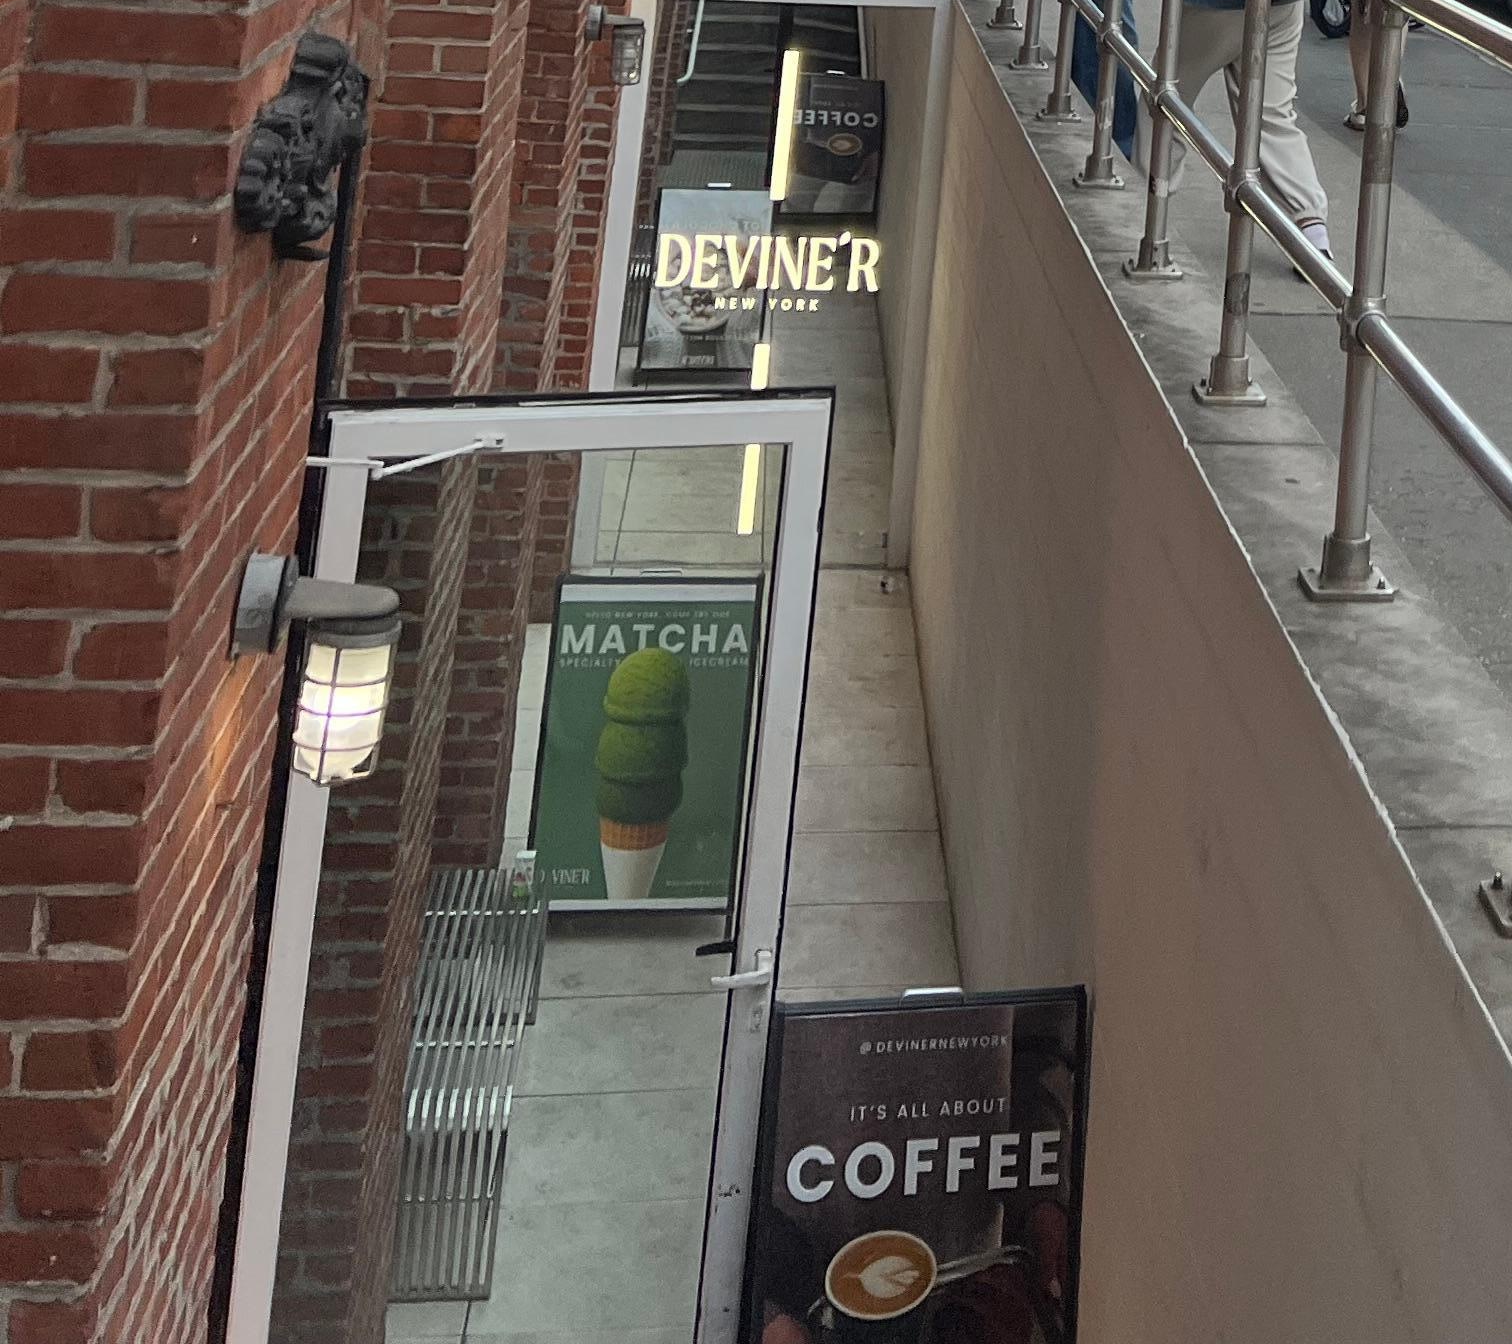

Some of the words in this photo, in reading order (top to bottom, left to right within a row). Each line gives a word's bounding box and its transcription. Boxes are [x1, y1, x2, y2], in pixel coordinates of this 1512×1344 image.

[655, 231, 880, 293] DEVINE'R
[714, 297, 756, 311] NEW
[768, 298, 820, 312] YORK
[560, 623, 749, 655] MATCHA
[850, 1103, 887, 1122] IT'S
[896, 1102, 930, 1119] ALL
[939, 1097, 1009, 1117] ABOUT
[786, 1130, 1062, 1204] COFFEE
